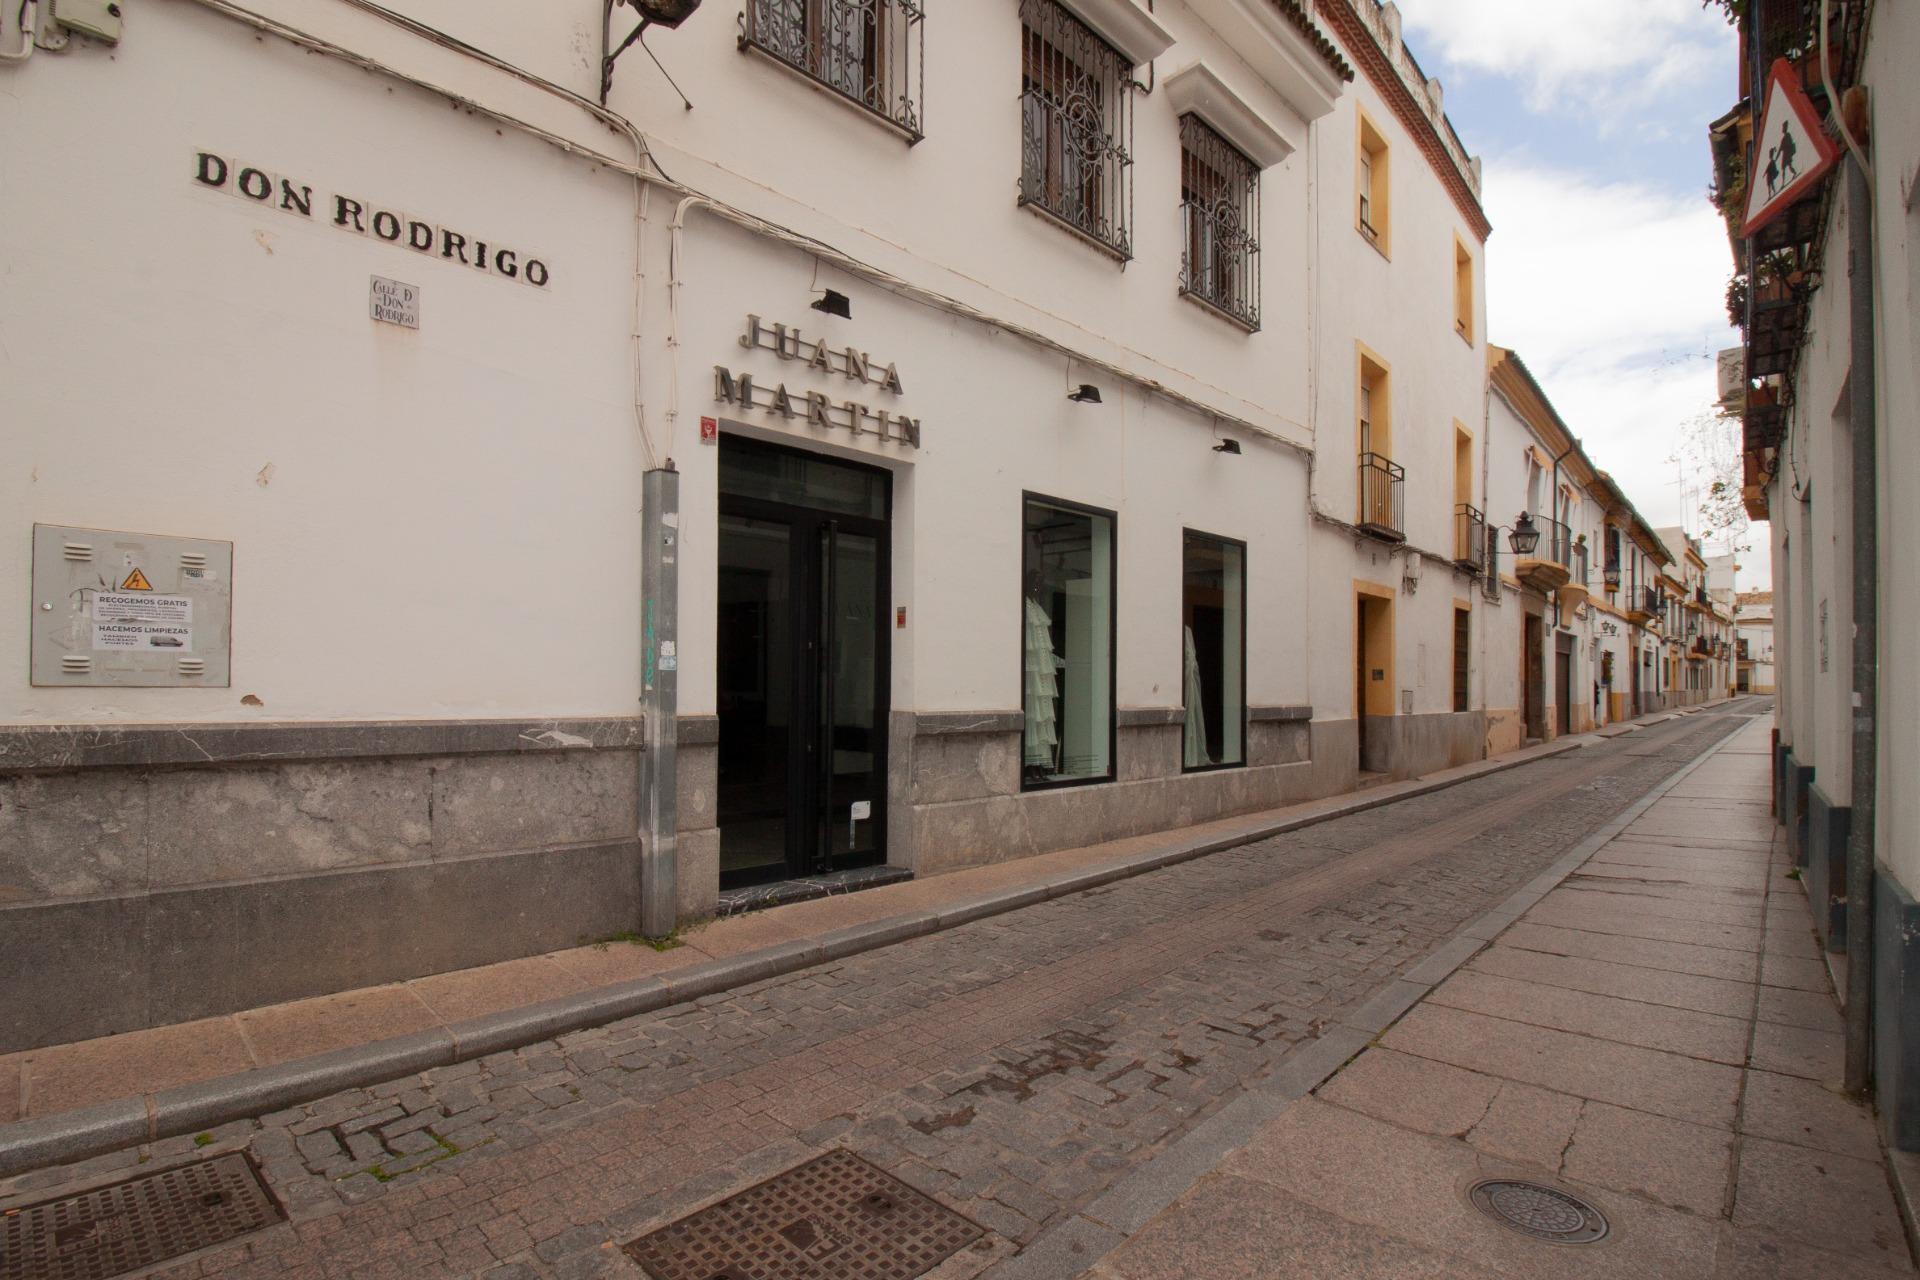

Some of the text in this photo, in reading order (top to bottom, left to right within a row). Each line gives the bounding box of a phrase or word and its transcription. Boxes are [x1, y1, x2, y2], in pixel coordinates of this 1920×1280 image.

[195, 152, 549, 286] DON RODRIGO
[383, 293, 404, 309] DON
[375, 304, 414, 325] RODRIGO
[738, 314, 904, 395] JUANA
[713, 365, 921, 449] MARTIN
[99, 596, 156, 606] RECOGEMOS
[157, 599, 188, 607] GRATIS
[98, 625, 189, 635] HACEMOS LIMPIEZAS
